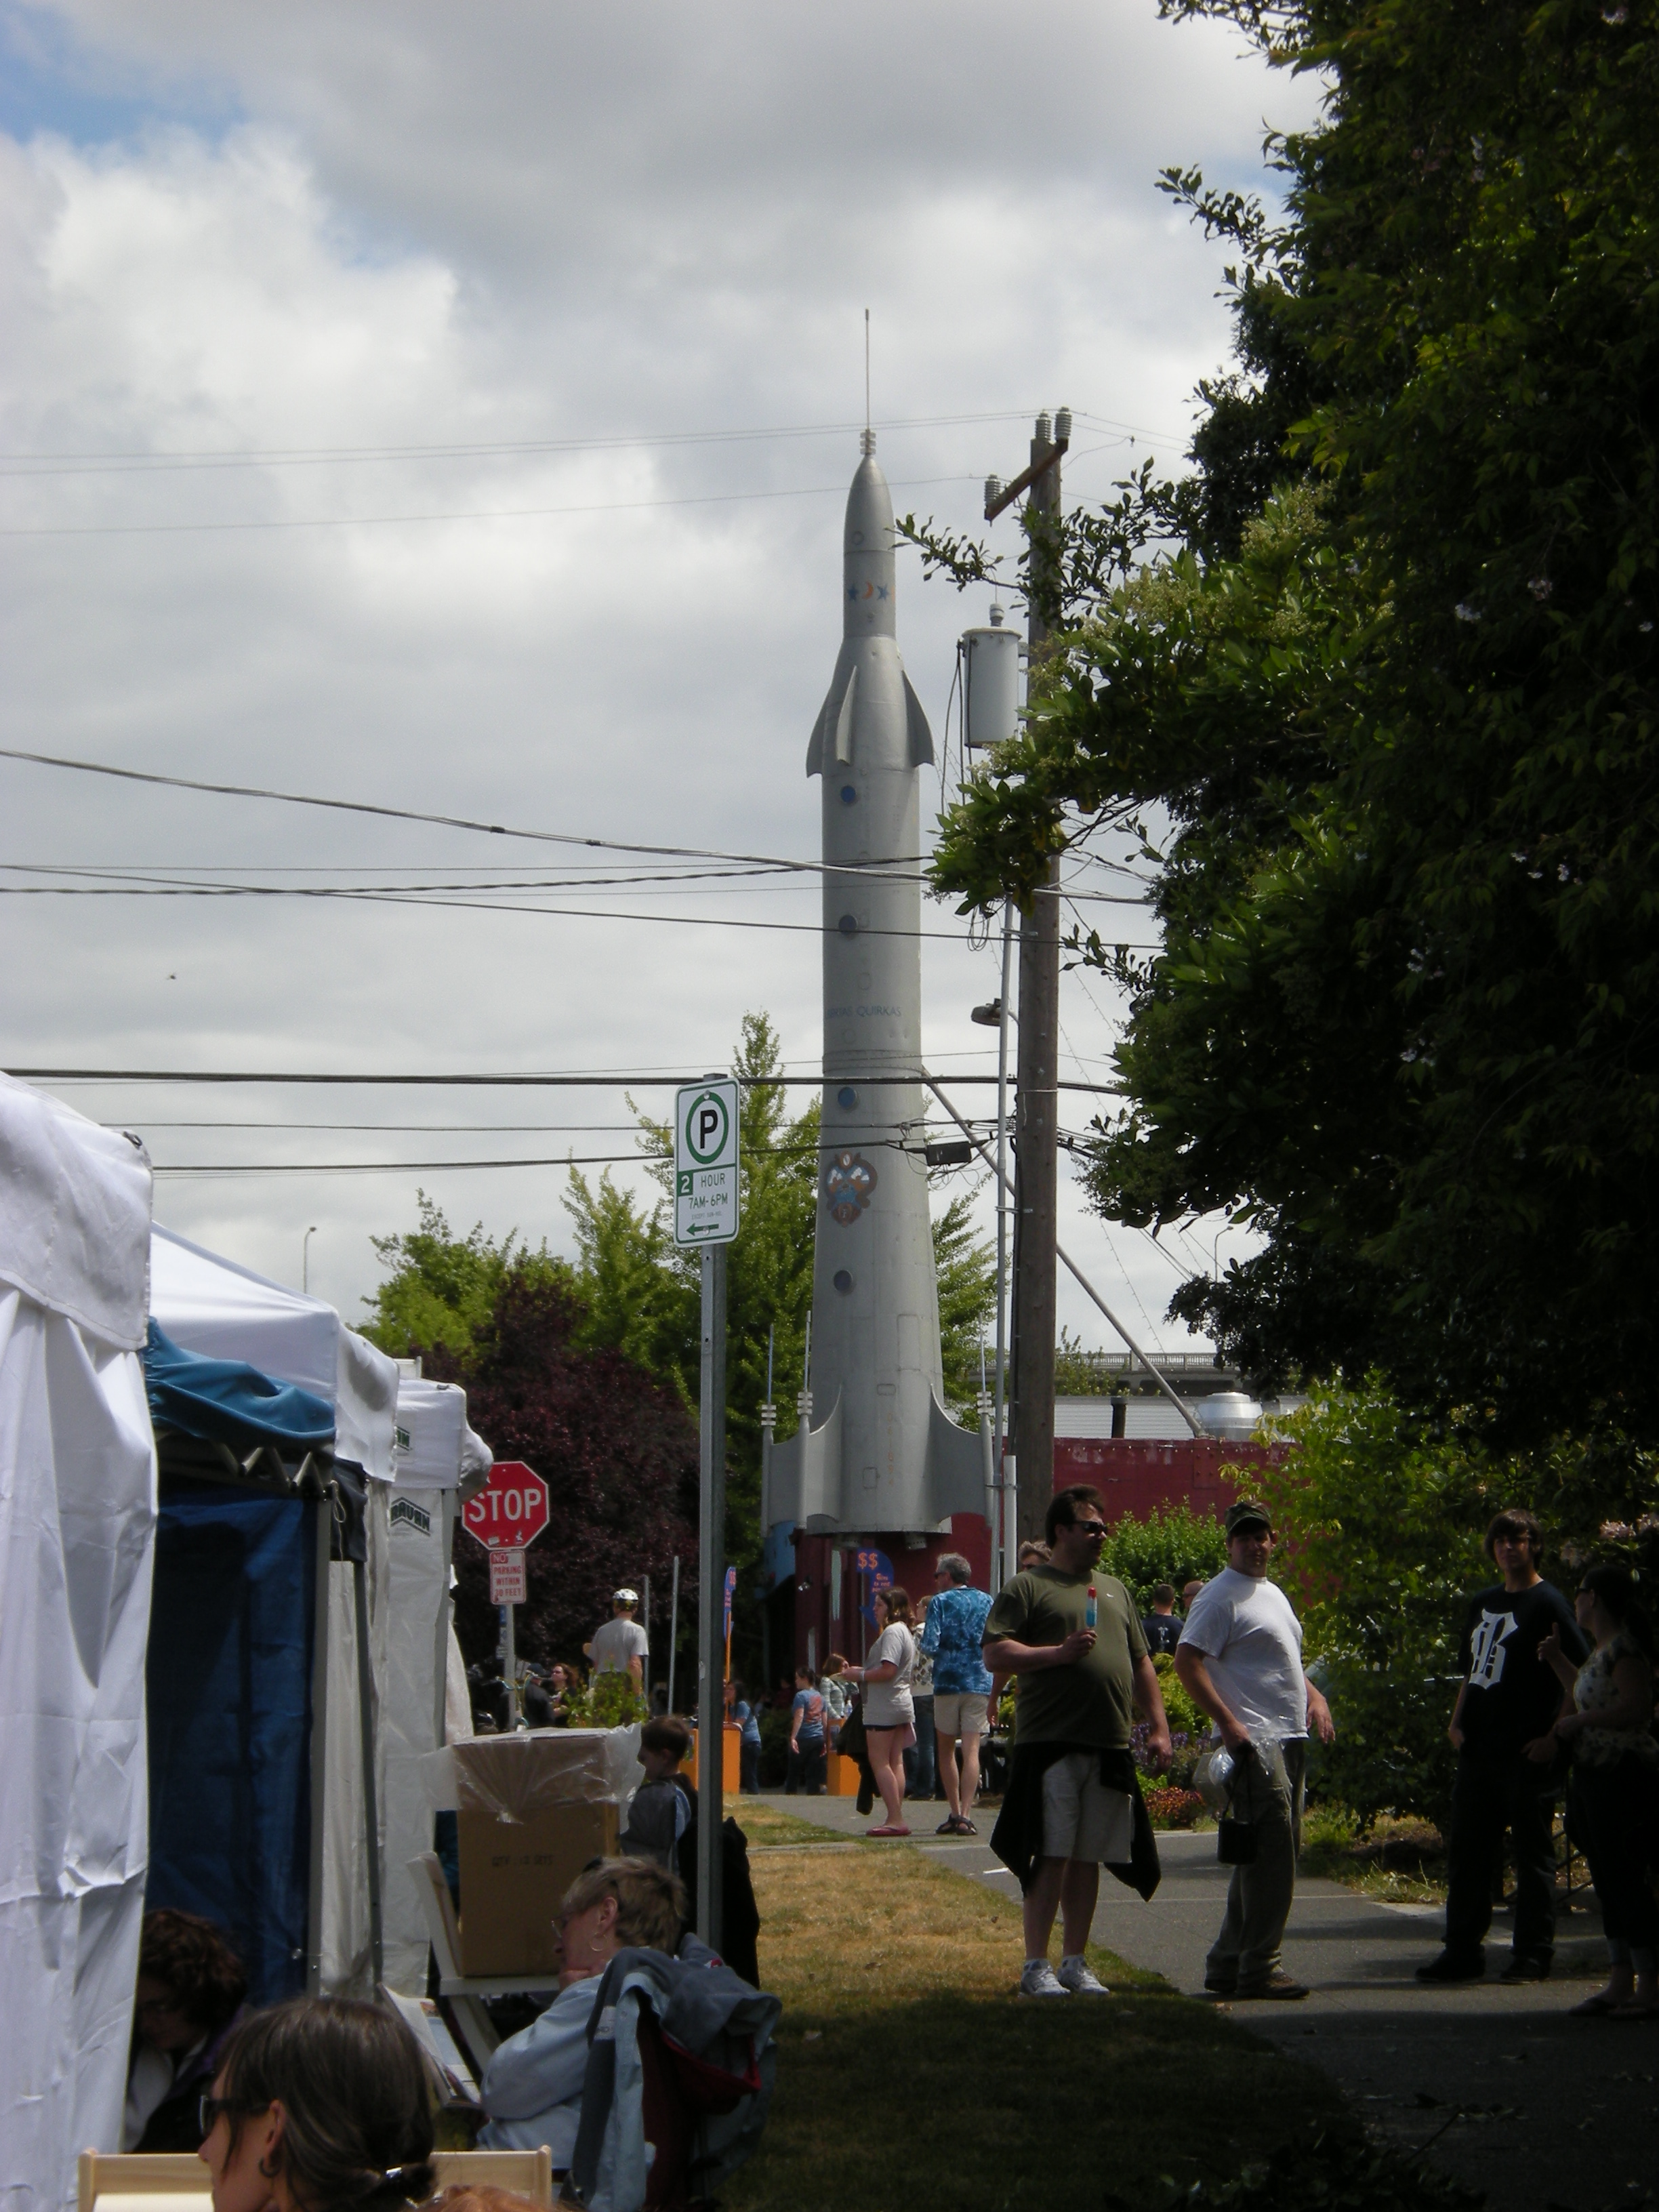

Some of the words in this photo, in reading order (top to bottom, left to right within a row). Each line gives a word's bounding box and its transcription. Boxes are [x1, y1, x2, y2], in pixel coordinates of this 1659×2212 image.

[857, 1005, 901, 1018] QUIRKAS
[699, 1109, 718, 1149] P
[680, 1174, 691, 1193] 2
[700, 1173, 726, 1188] HOUR
[469, 1488, 541, 1523] STOP
[493, 1553, 506, 1562] NO
[493, 1565, 522, 1575] PARKING
[496, 1577, 520, 1586] WITHIN
[505, 1587, 521, 1597] FEET
